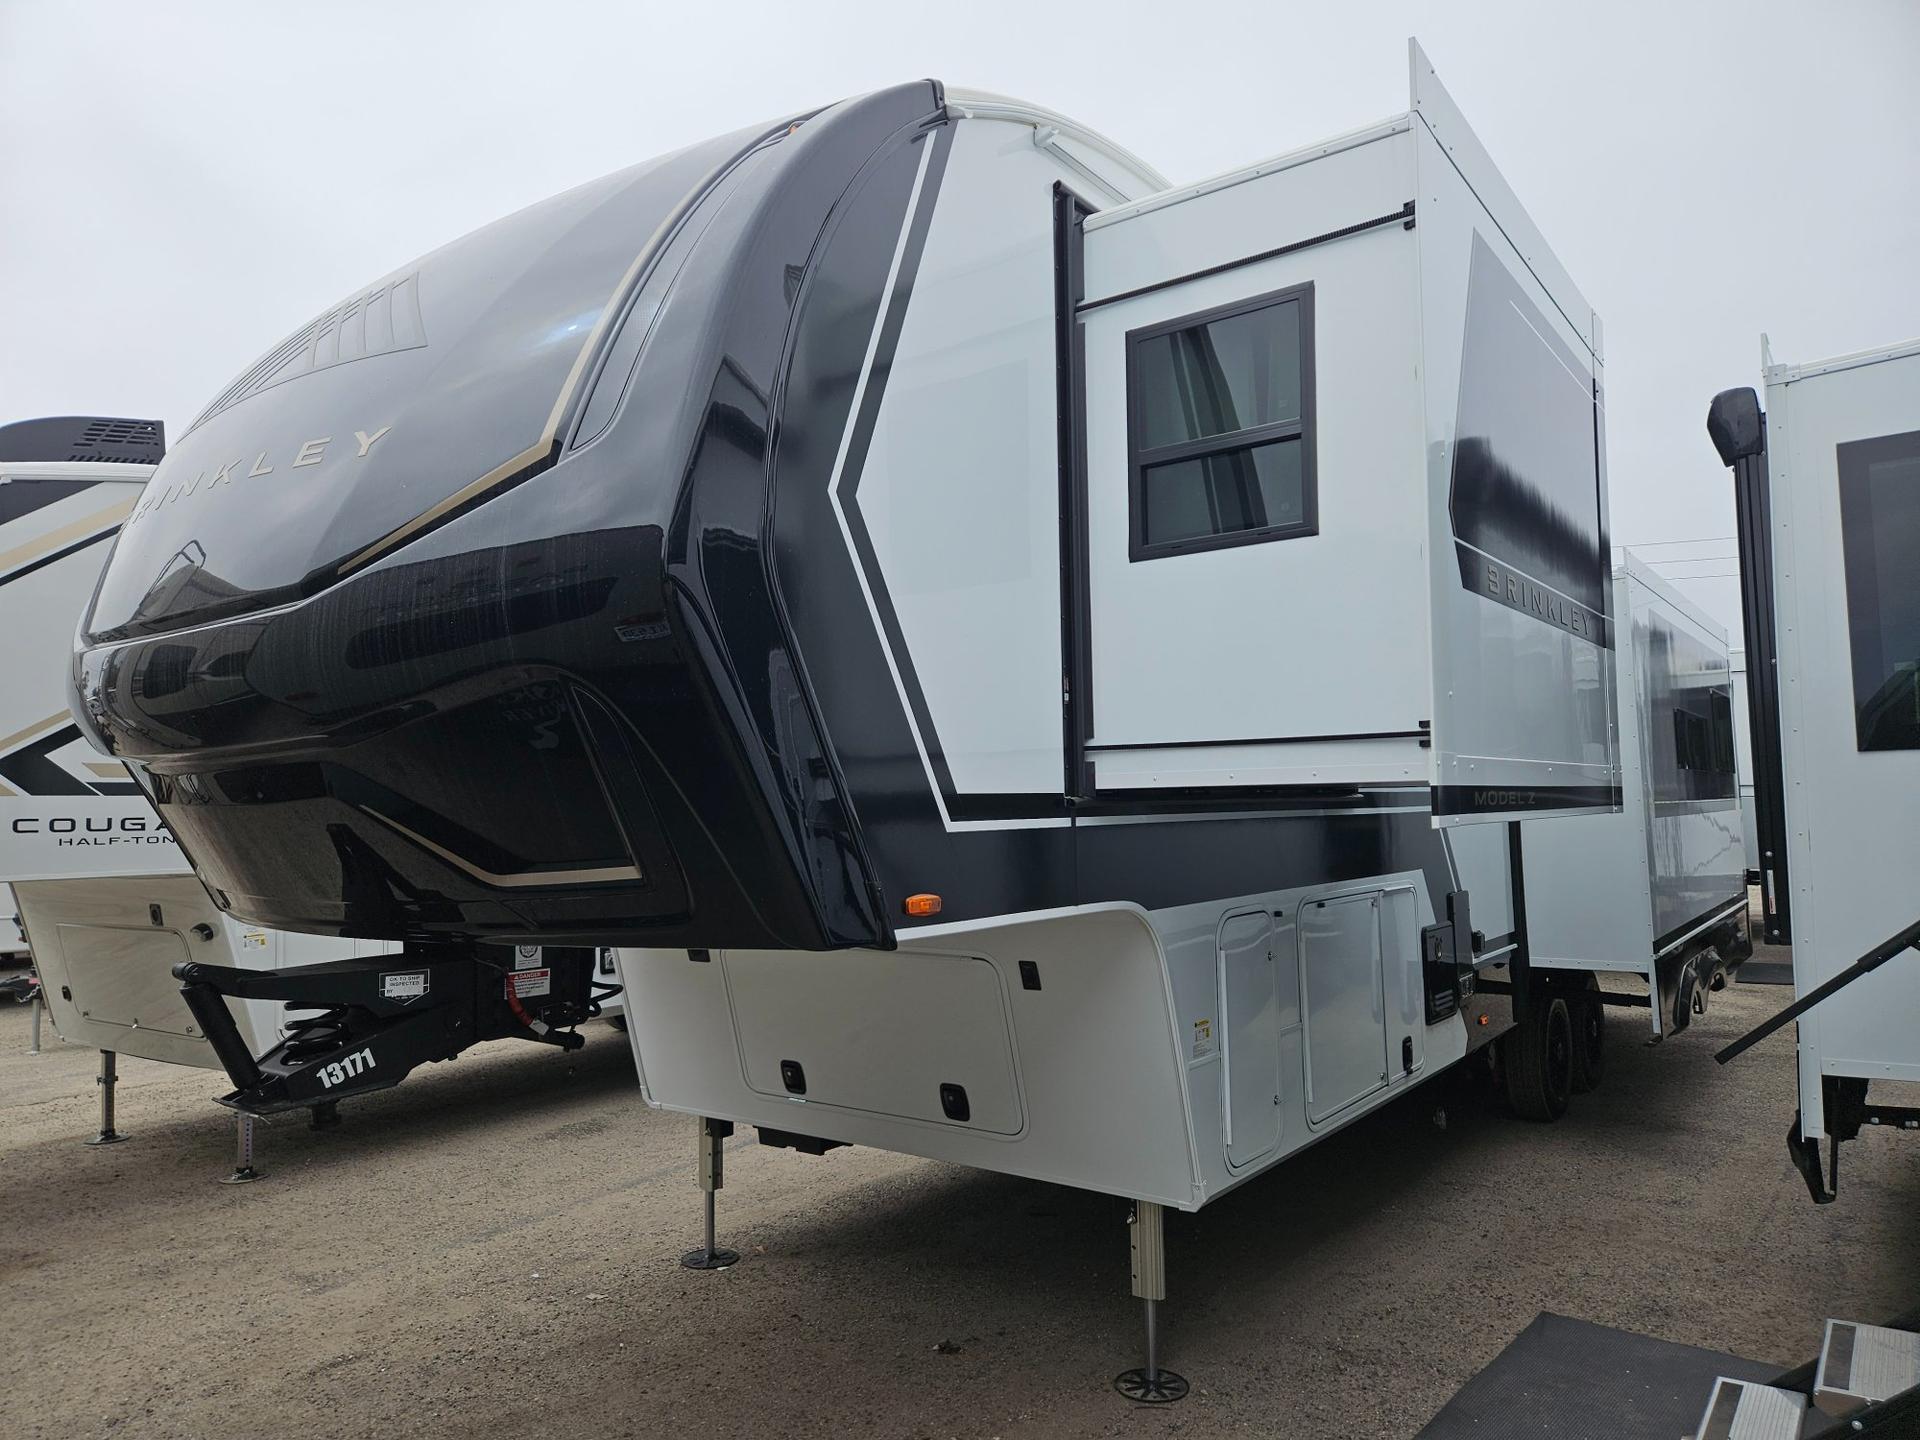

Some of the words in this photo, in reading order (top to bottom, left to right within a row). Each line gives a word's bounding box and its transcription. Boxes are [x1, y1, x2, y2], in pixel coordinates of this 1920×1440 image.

[121, 424, 392, 528] RINKLEY
[1487, 564, 1591, 635] BRINKLEY
[1474, 790, 1525, 806] MODEL
[1527, 791, 1536, 805] Z
[58, 836, 176, 847] HALF-TON
[519, 971, 541, 980] DANGER
[316, 1047, 377, 1089] 13171
